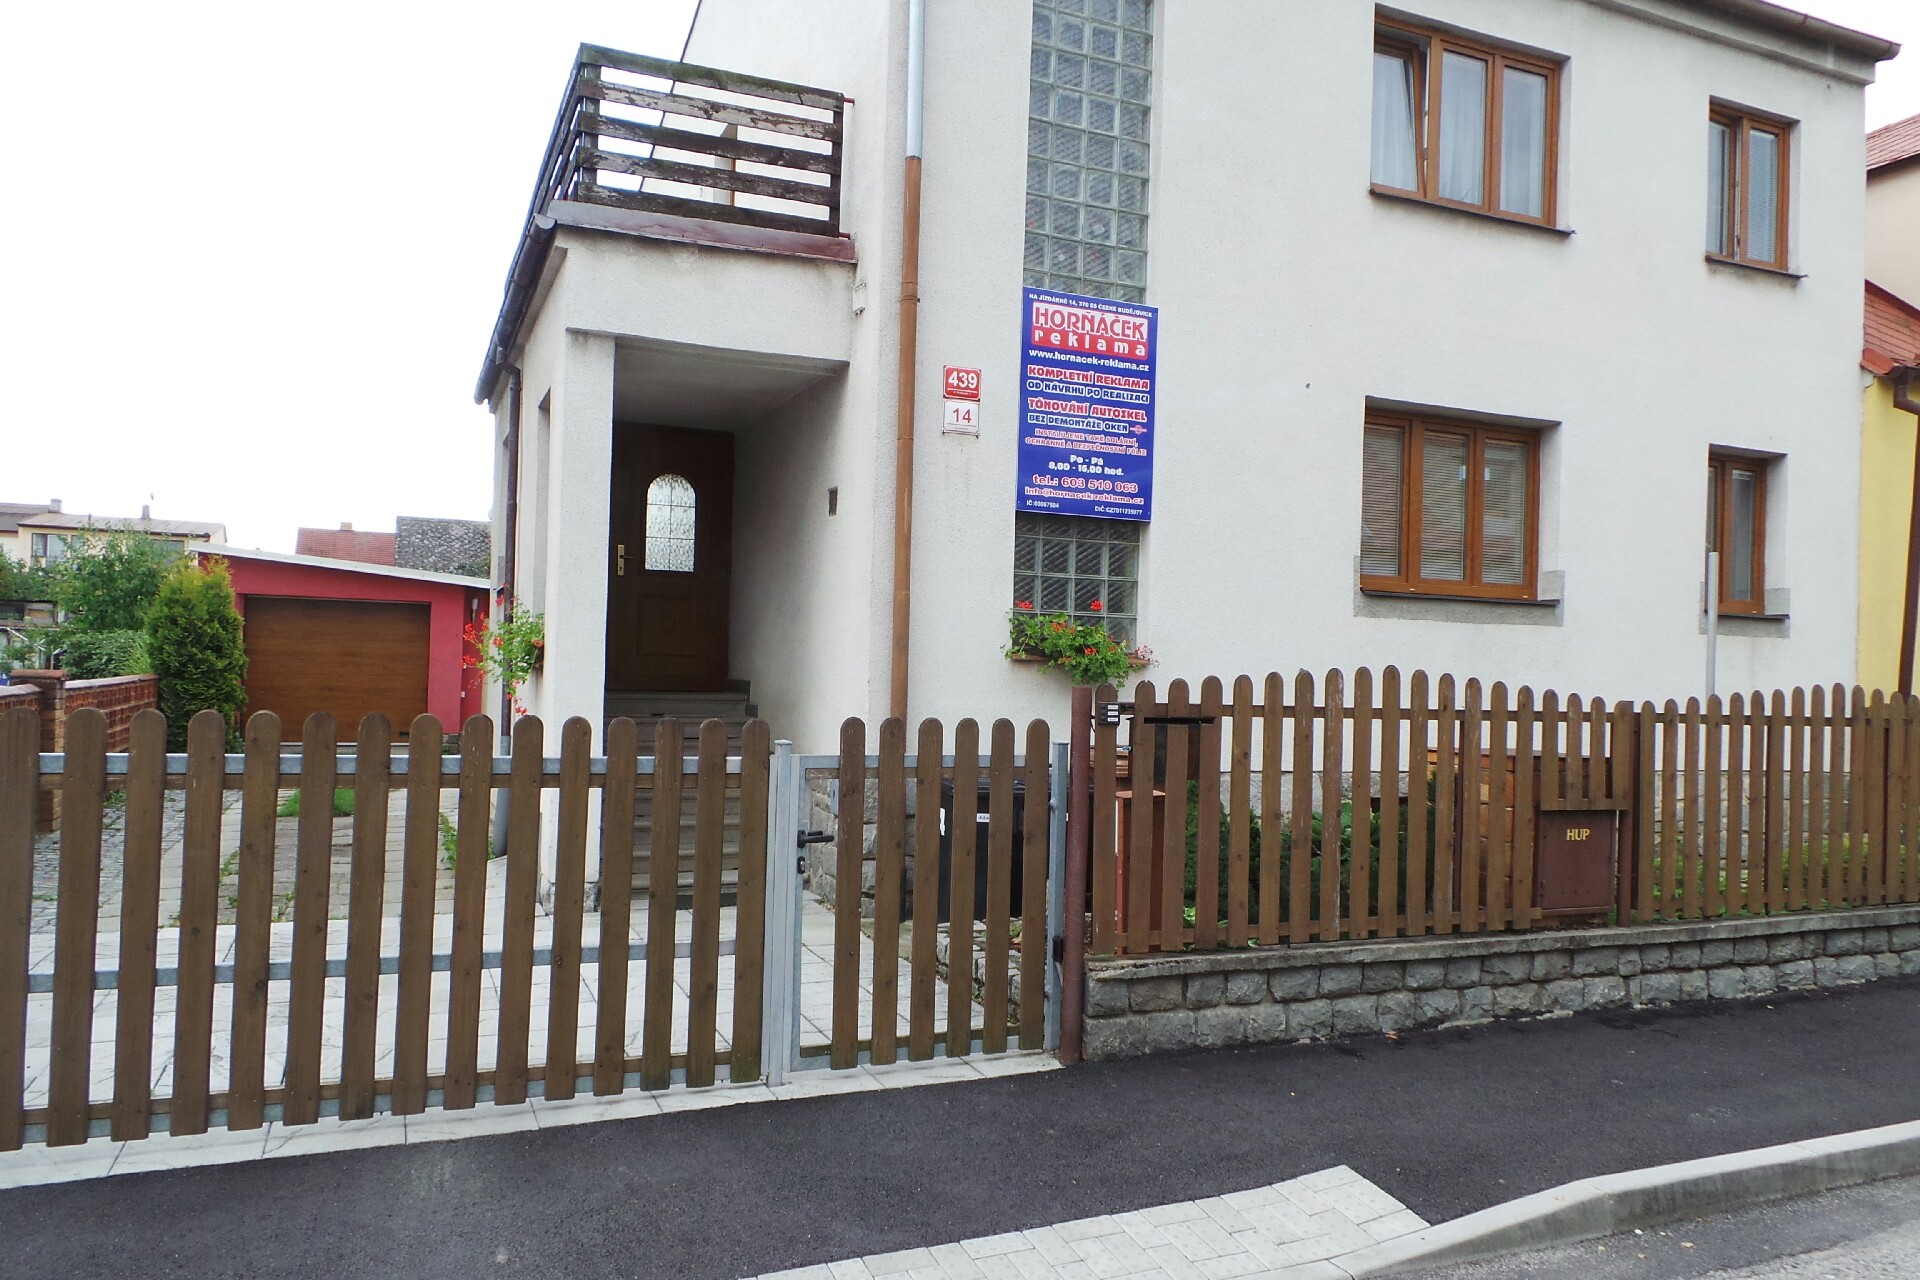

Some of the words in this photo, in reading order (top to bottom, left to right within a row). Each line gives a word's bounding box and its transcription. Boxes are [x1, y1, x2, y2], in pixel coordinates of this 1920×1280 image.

[1118, 307, 1153, 318] BUDĚJOVICE
[1034, 329, 1146, 356] reklama
[1028, 349, 1150, 371] www.hornacek-reklama.cz
[947, 370, 978, 389] 439
[1028, 365, 1094, 381] KOMPLETNÍ
[1095, 372, 1150, 390] REKLAMA
[1027, 381, 1042, 390] OD
[1043, 381, 1085, 396] NÁVRHU
[1086, 386, 1101, 398] PO
[1102, 389, 1150, 404] REALIZACI
[953, 408, 971, 423] 14
[1028, 397, 1090, 415] TÓNOVÁNÍ
[1091, 405, 1147, 422] AUTOSKEL
[1028, 413, 1046, 424] BEZ
[1047, 415, 1103, 430] DEMONTÁŽE
[1103, 421, 1129, 433] OKEN
[1035, 428, 1085, 440] INSTALUJEME
[1025, 436, 1065, 448] OCHRANNÉ
[1066, 441, 1072, 449] A
[1073, 441, 1127, 455] BEZPEČNOSTNÍ
[1070, 454, 1083, 463] Po
[1104, 466, 1124, 476] hod.
[1033, 474, 1058, 486] tel.:
[1061, 477, 1086, 489] 603
[1087, 479, 1112, 491] 510
[1114, 482, 1139, 493] 063
[1566, 829, 1590, 840] HUP
